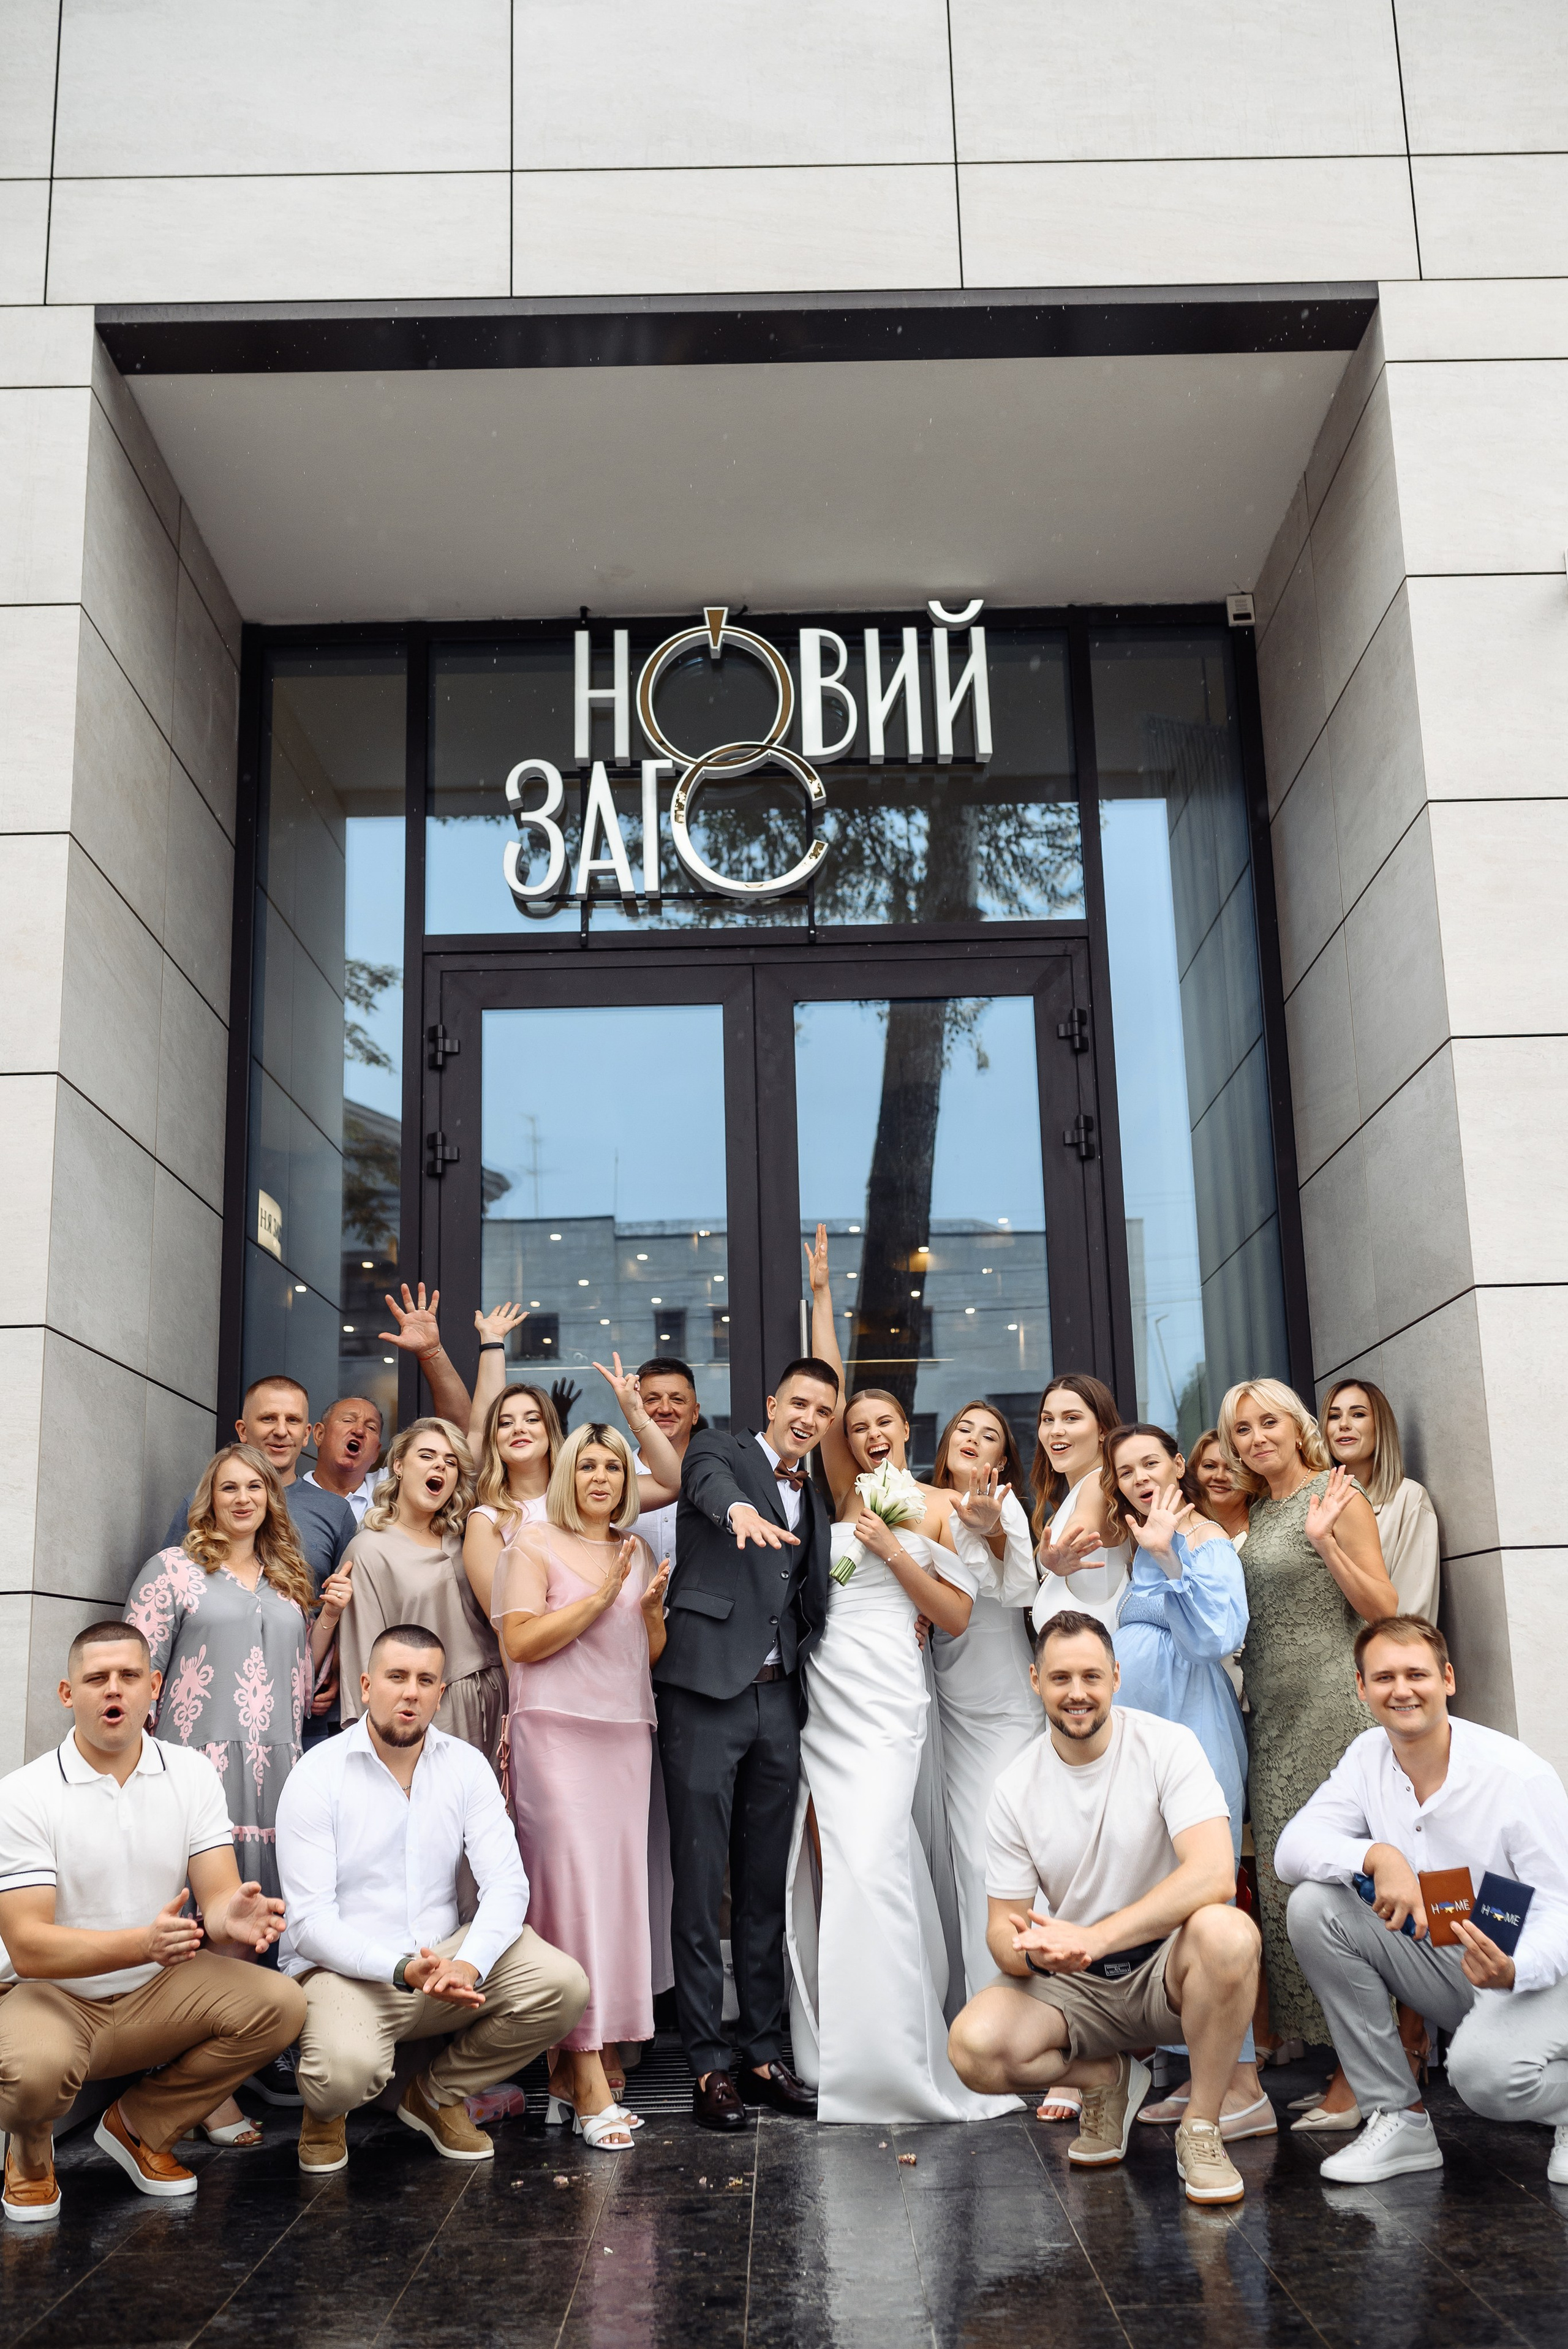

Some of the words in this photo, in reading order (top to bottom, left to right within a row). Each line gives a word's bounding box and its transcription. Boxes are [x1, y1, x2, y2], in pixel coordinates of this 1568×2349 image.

[573, 599, 993, 777] НОВИЙ
[503, 741, 829, 901] ЗАГС
[1430, 1899, 1471, 1915] HME
[1480, 1903, 1521, 1927] HME
